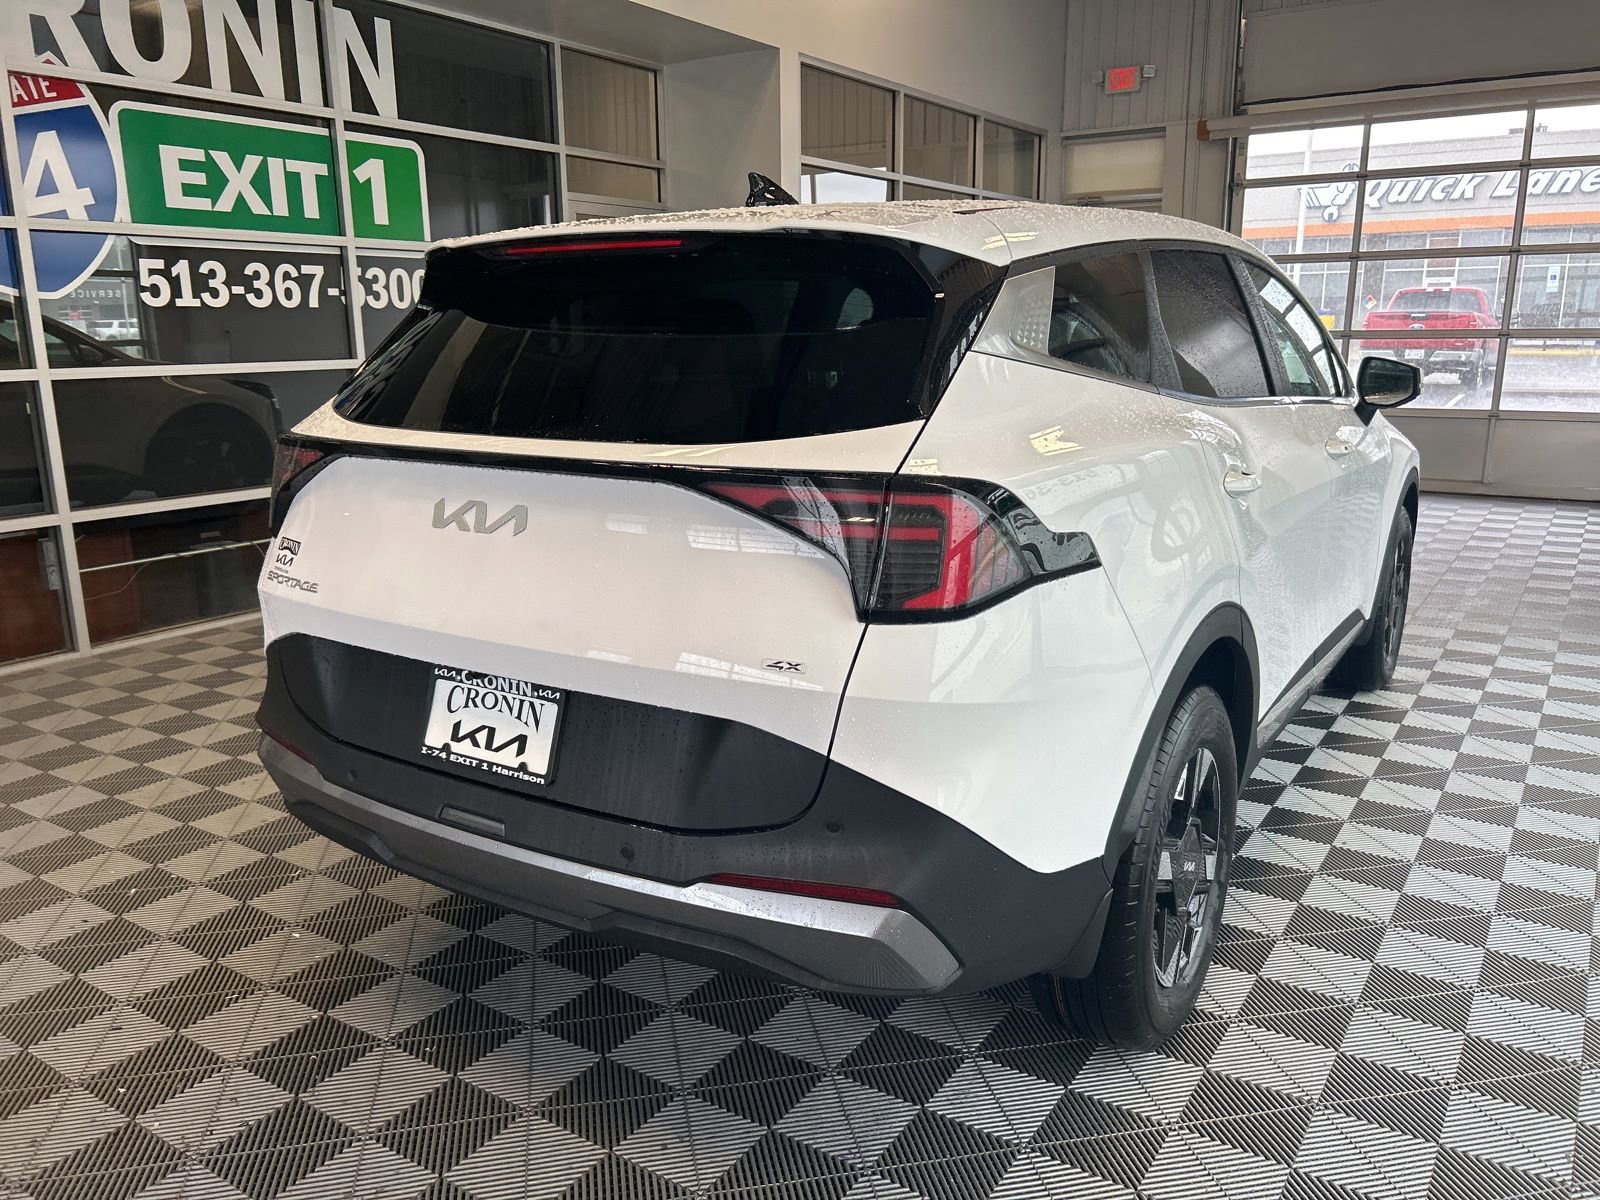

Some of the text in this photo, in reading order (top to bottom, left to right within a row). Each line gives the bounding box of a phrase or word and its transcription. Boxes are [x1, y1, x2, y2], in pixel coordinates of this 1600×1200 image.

[159, 144, 389, 226] EXIT 1
[1365, 168, 1600, 208] Quick Lane
[432, 498, 528, 537] KIA
[267, 570, 318, 593] SPORTAGE
[447, 685, 545, 733] CRONIN
[450, 719, 528, 758] KIA
[421, 746, 545, 785] I-74 EXIT 1 Harrison
